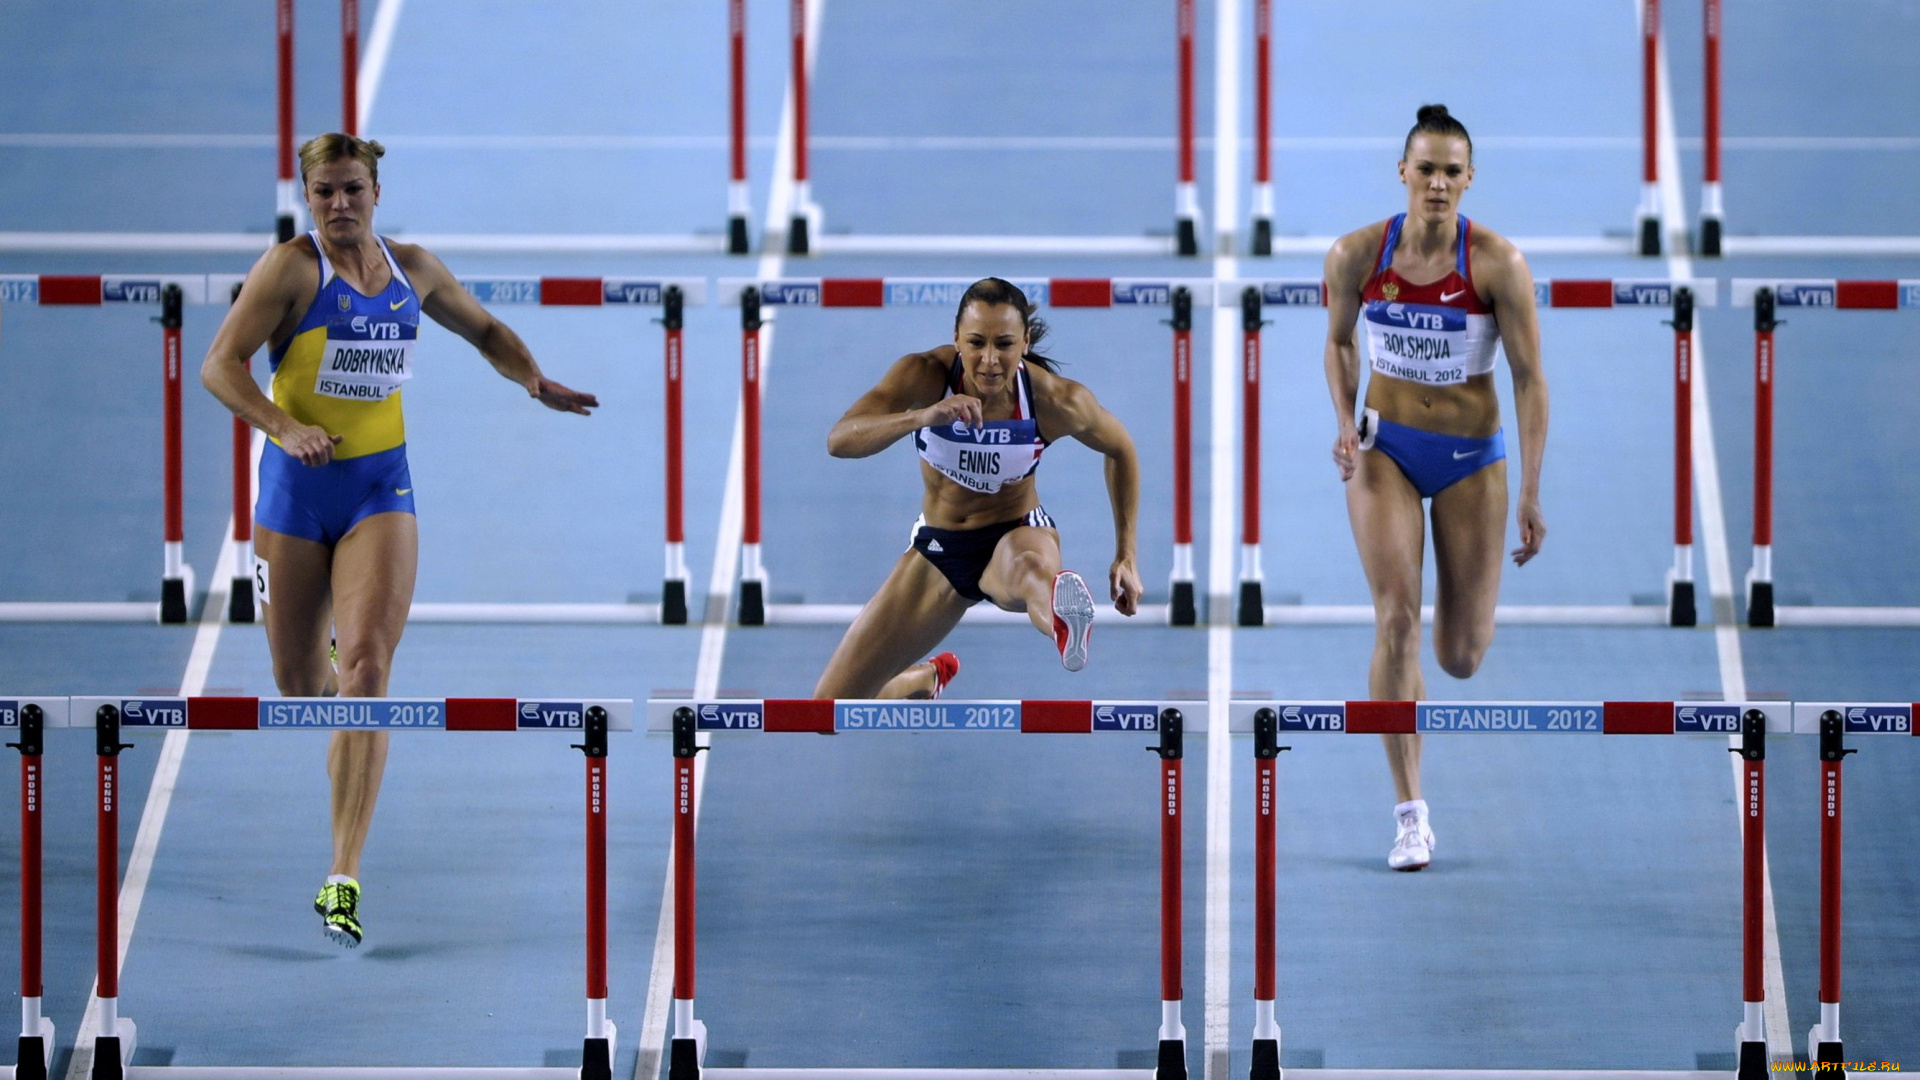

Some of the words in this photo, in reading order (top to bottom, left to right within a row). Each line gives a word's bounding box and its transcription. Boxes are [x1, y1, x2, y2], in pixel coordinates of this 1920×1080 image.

[125, 285, 158, 302] VTB
[490, 282, 534, 302] 2012
[625, 286, 659, 303] VTB
[1134, 287, 1168, 304] VTB
[1284, 287, 1318, 304] VTB
[1635, 287, 1669, 305] VTB
[1798, 288, 1832, 306] VTB
[1407, 311, 1443, 330] VTB
[369, 323, 400, 339] VTB
[1383, 332, 1450, 361] BOLSHOVA
[332, 347, 404, 374] DOBRYNSKA
[1376, 356, 1431, 382] ISTANBUL
[1435, 368, 1462, 382] 2012
[320, 380, 383, 398] ISTANBUL
[973, 428, 1011, 443] VTB
[959, 449, 1000, 475] ENNIS
[146, 708, 183, 725] VTB
[268, 705, 379, 725] ISTANBUL
[389, 706, 439, 726] 2012
[543, 710, 580, 727] VTB
[723, 712, 760, 728] VTB
[844, 707, 955, 728] ISTANBUL
[965, 708, 1015, 728] 2012
[1118, 713, 1155, 730] VTB
[1303, 713, 1342, 730] VTB
[1425, 709, 1537, 729] ISTANBUL
[1547, 709, 1597, 730] 2012
[1700, 715, 1738, 731] VTB
[1870, 715, 1907, 731] VTB
[28, 774, 36, 812] MONDO
[104, 774, 112, 812] MONDO
[592, 776, 600, 813] MONDO
[681, 776, 689, 814] MONDO
[1168, 778, 1176, 816] MONDO
[1262, 778, 1270, 815] MONDO
[1750, 779, 1758, 817] MONDO
[1827, 779, 1835, 817] MONDO
